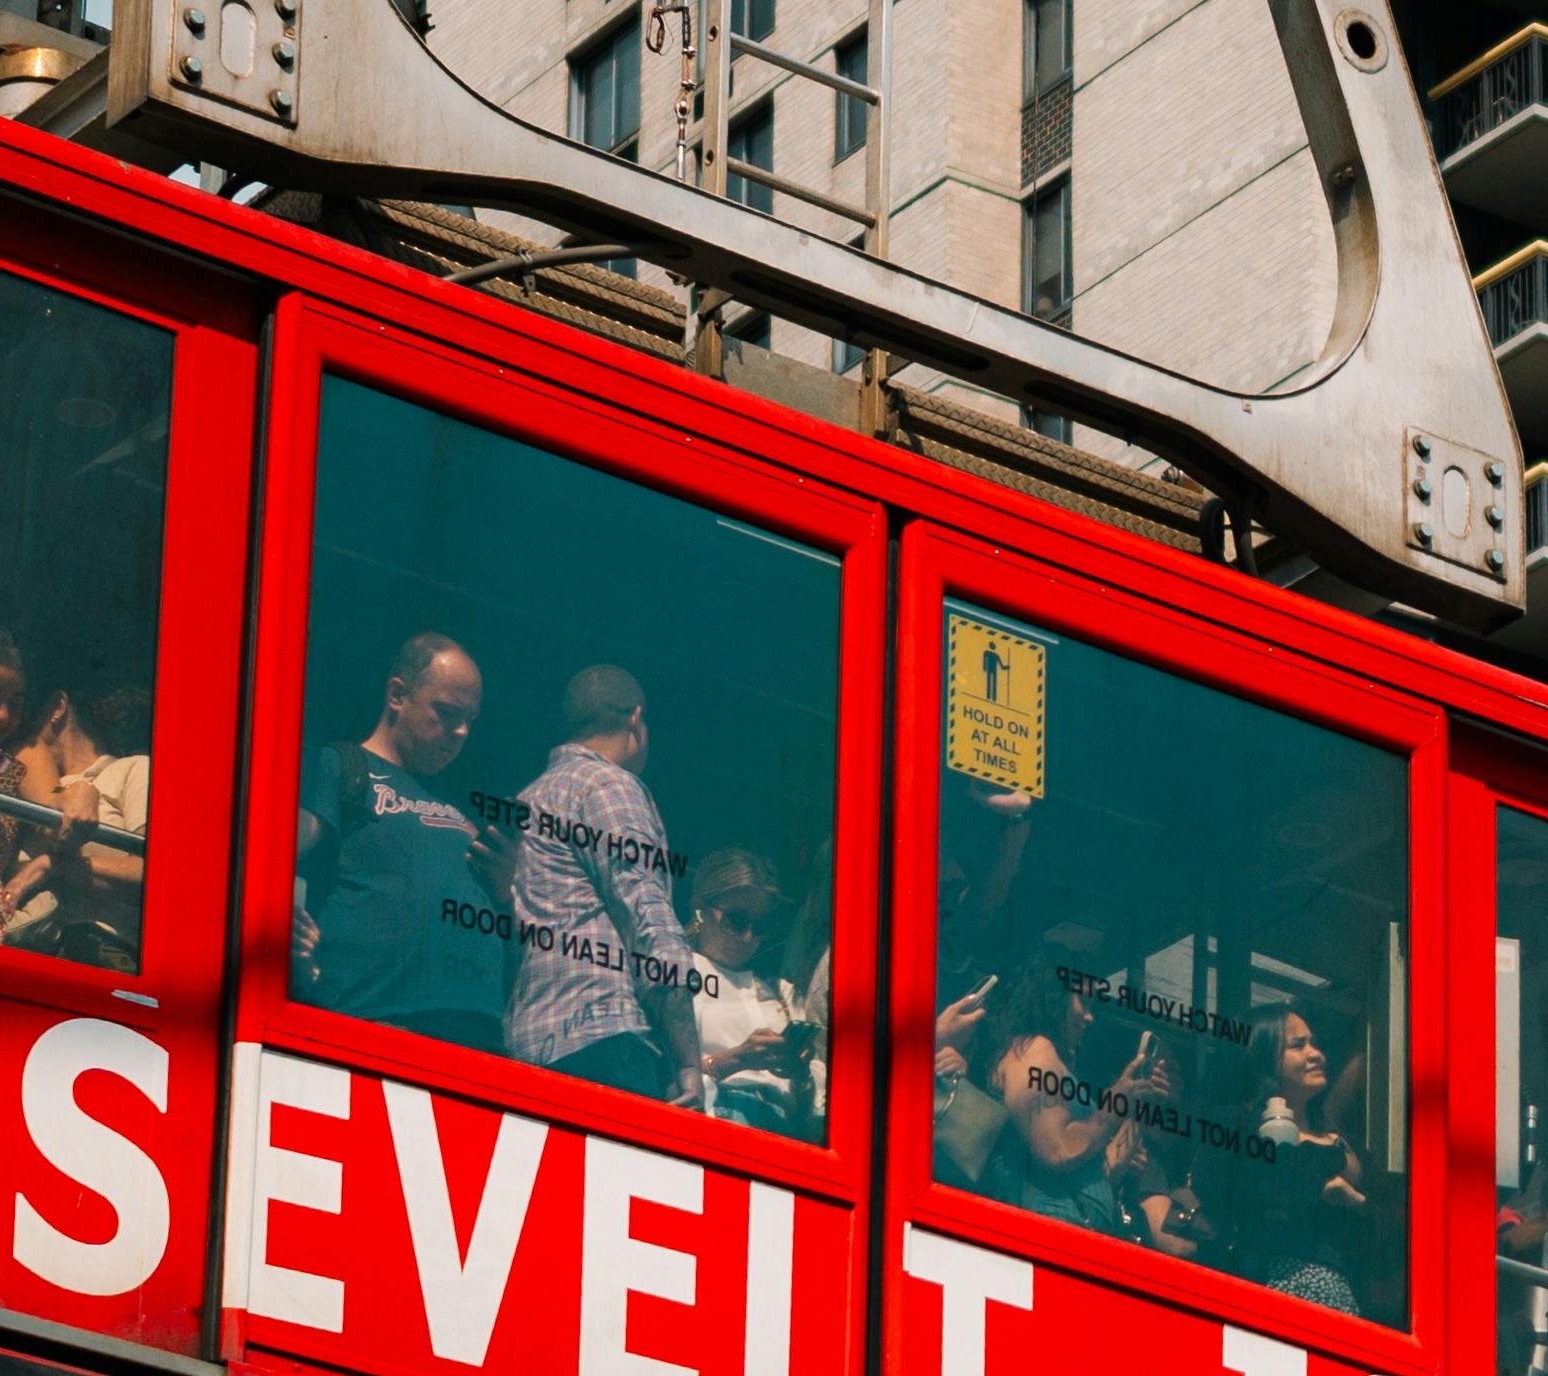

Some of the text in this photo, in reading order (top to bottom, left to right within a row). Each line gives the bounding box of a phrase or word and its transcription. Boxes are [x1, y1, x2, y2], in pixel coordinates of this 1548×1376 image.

[963, 705, 1029, 739] HOLD ON
[971, 728, 1021, 756] AT ALL
[973, 747, 1018, 774] TIMES
